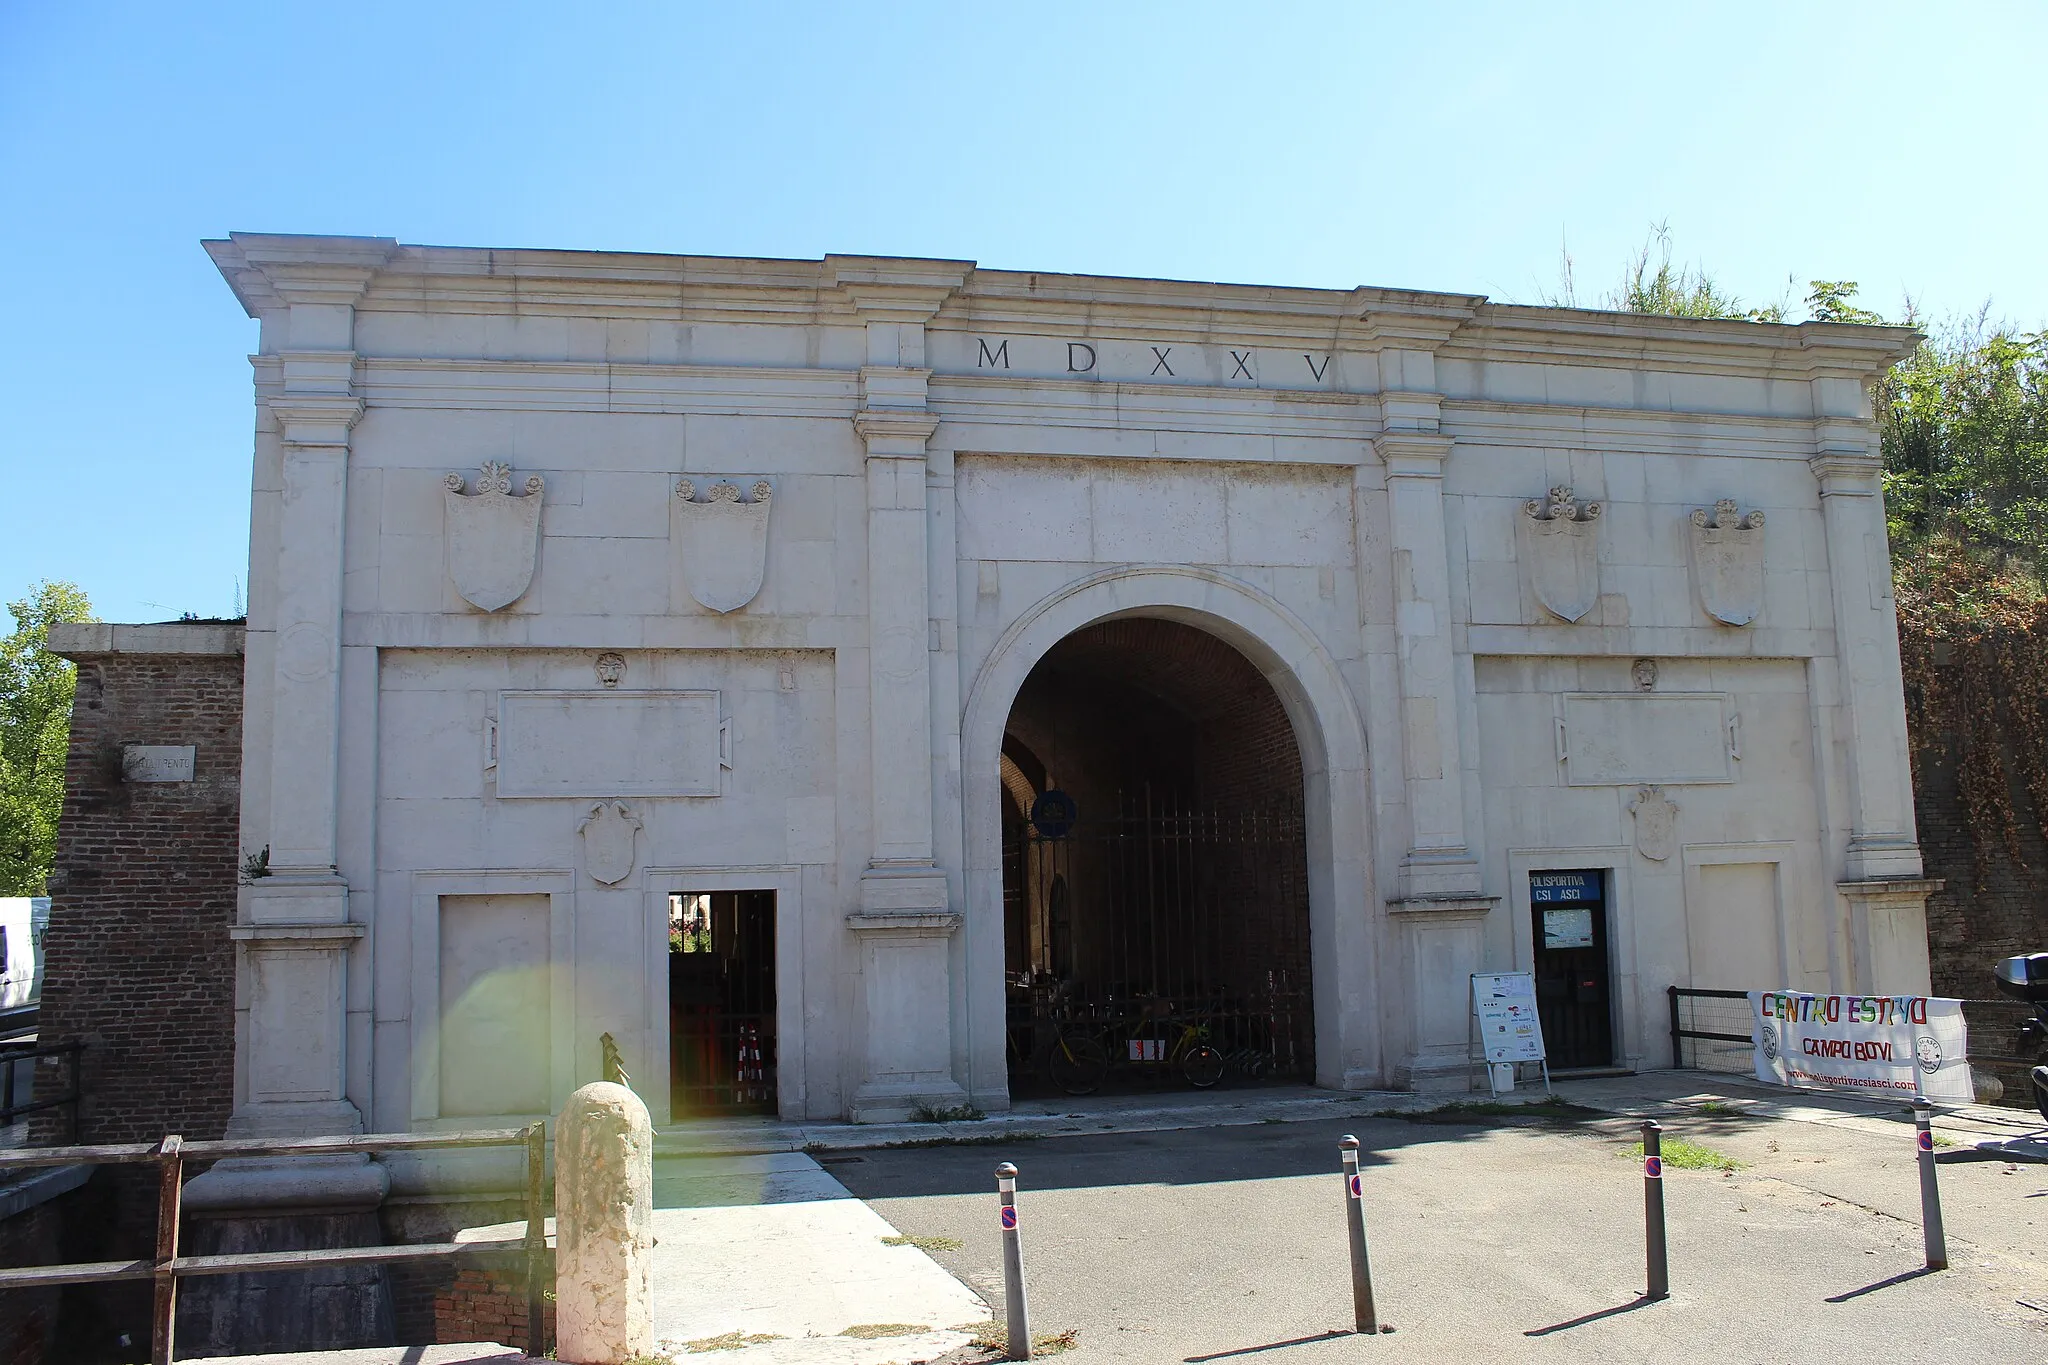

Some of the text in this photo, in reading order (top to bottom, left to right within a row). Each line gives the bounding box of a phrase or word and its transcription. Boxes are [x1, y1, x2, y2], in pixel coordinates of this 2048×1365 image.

[1529, 876, 1585, 887] POLISPORTIVA
[1535, 889, 1580, 901] CSI ASCI
[1761, 992, 1928, 1026] CENTRO ESTIVO
[1802, 1037, 1892, 1062] CAMPO BOVI
